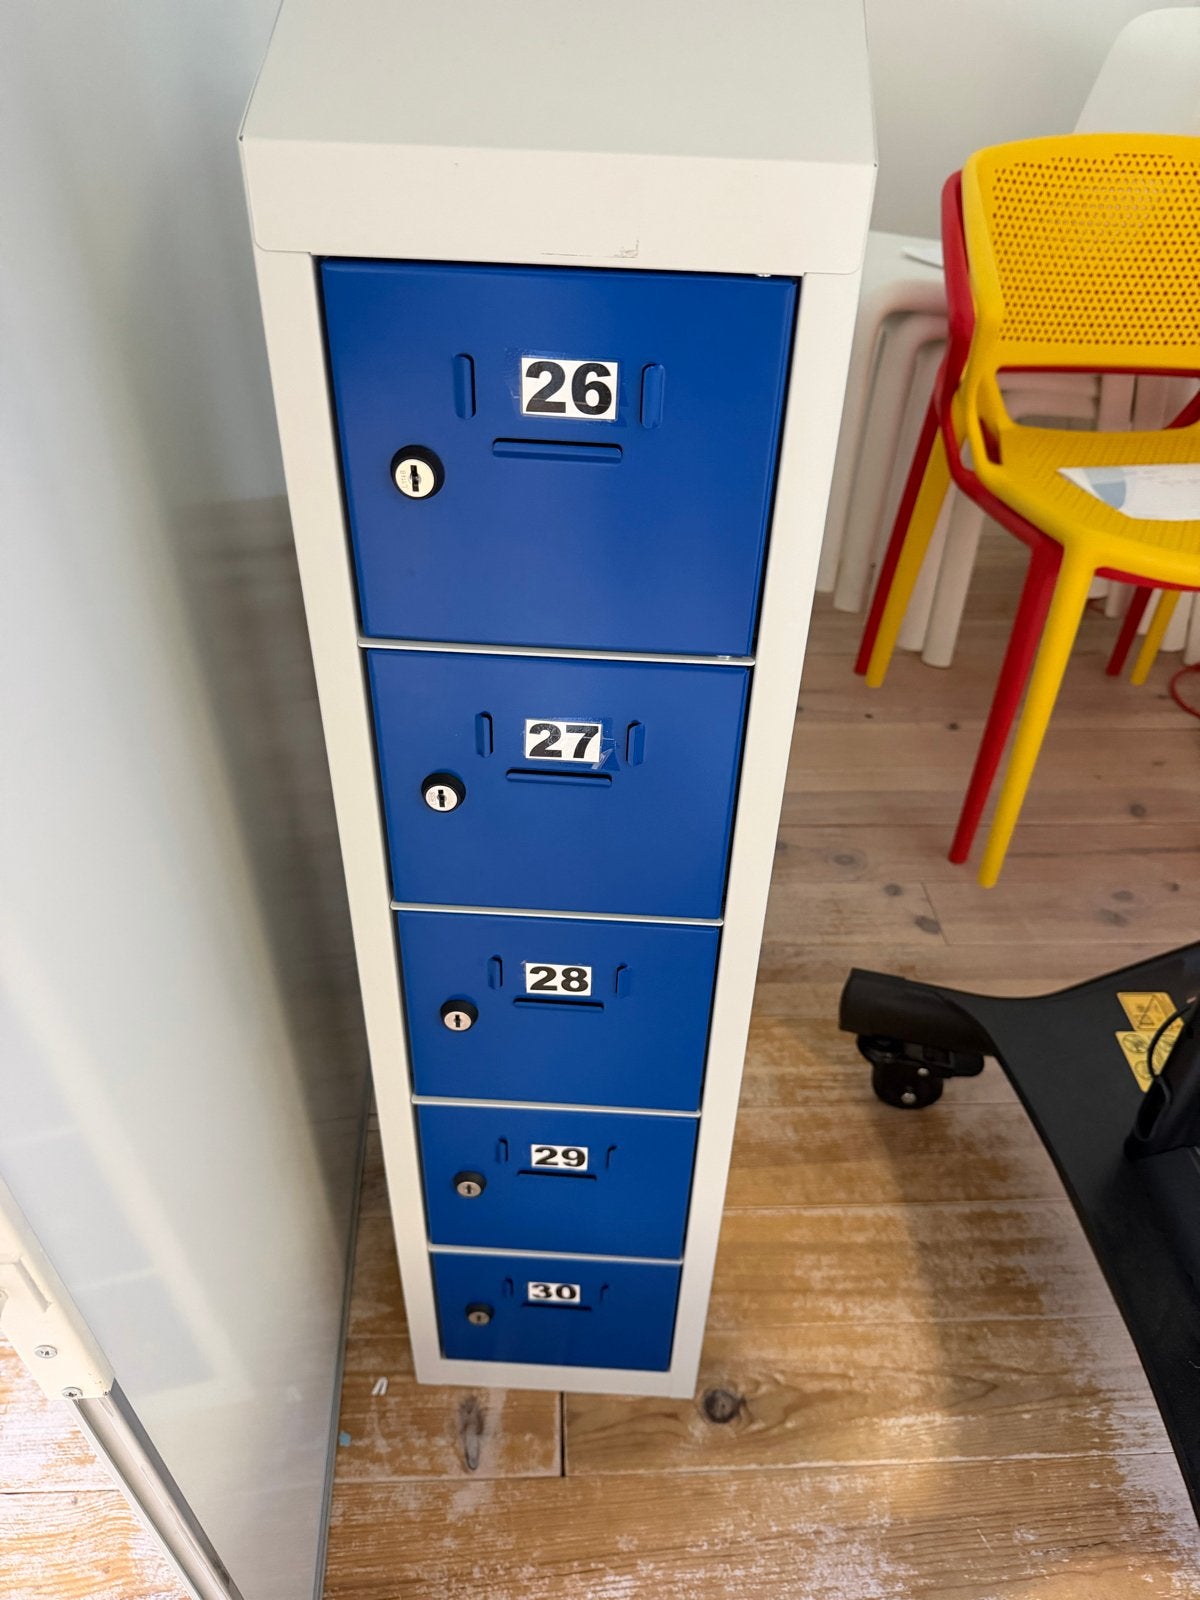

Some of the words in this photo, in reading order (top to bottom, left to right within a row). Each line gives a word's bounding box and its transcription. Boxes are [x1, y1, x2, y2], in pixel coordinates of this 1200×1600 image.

[525, 361, 612, 415] 26
[529, 723, 599, 759] 27
[529, 966, 589, 993] 28
[534, 1147, 587, 1168] 29
[532, 1284, 577, 1300] 30
